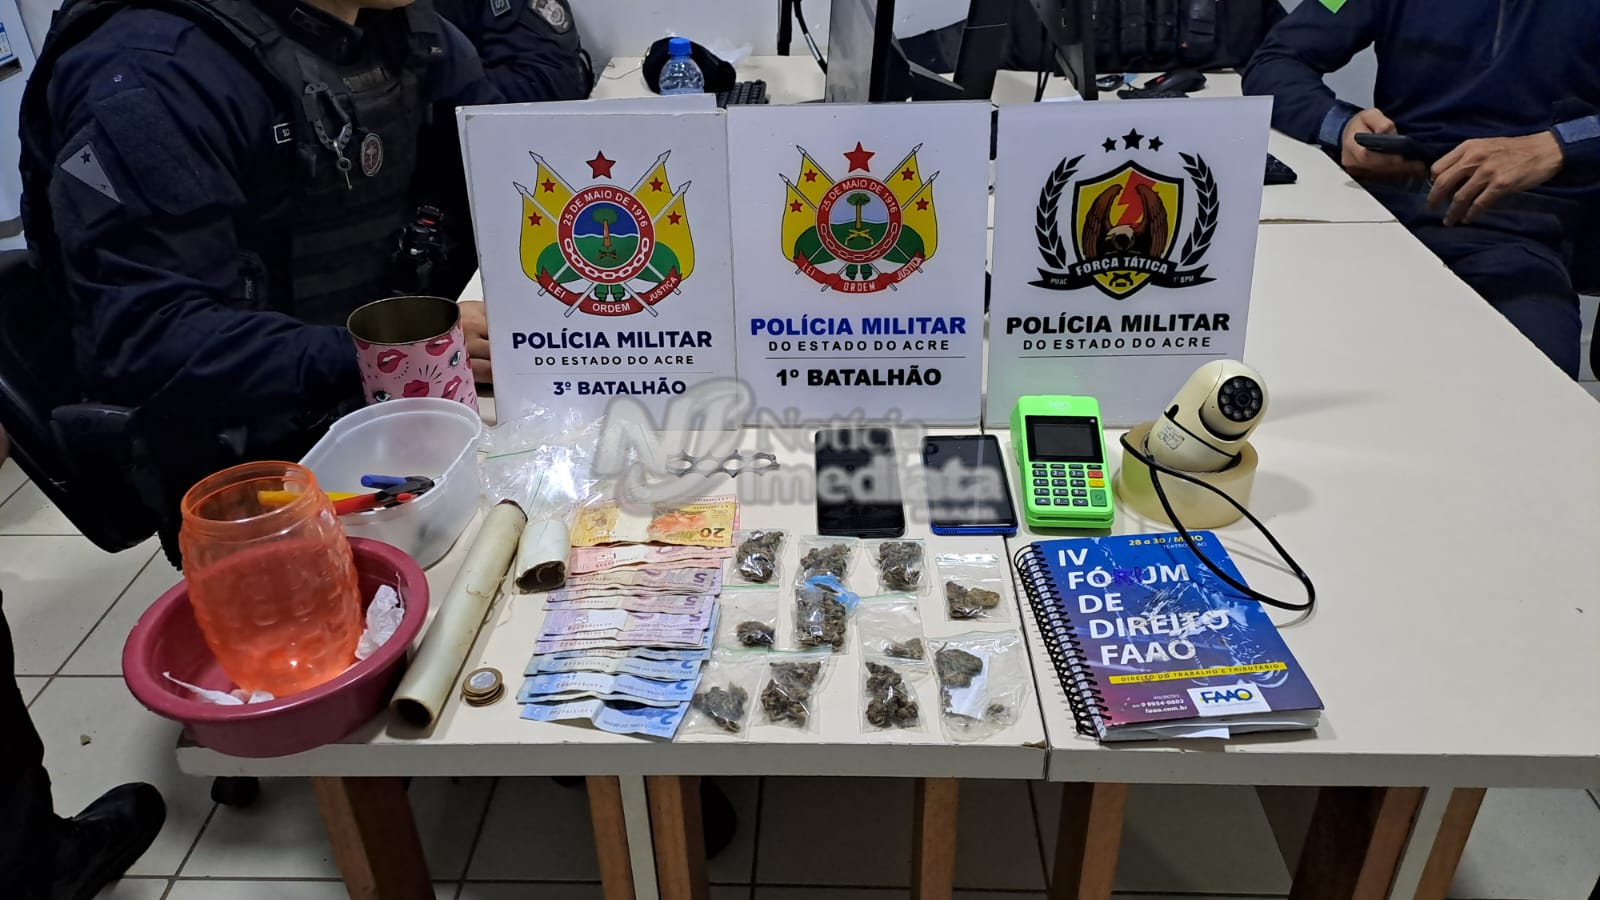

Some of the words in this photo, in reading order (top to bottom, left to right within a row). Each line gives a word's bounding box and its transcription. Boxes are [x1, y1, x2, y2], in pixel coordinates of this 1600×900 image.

[842, 180, 867, 190] MAIO
[869, 182, 884, 195] DE
[883, 192, 898, 213] 1916
[563, 212, 574, 226] 25
[569, 198, 584, 213] DE
[584, 190, 612, 202] MAIO
[615, 192, 630, 206] DE
[631, 204, 648, 227] 1916
[802, 262, 816, 277] LEI
[1075, 256, 1119, 276] FORÇA
[1123, 256, 1168, 274] TÁTICA
[548, 282, 566, 299] LEI
[648, 276, 678, 302] JUSTIÇA
[843, 282, 876, 292] ORDEM
[592, 302, 631, 313] ORDEM
[751, 314, 853, 336] POLÍCIA
[862, 316, 967, 335] MILITAR
[1006, 312, 1112, 335] POLÍCIA
[1121, 313, 1230, 332] MILITAR
[512, 328, 610, 349] POLÍCIA
[617, 331, 712, 348] MILITAR
[769, 341, 791, 351] DO
[798, 341, 867, 351] ESTADO
[874, 340, 896, 350] DO
[903, 340, 949, 350] ACRE
[1023, 340, 1046, 350] DO
[1053, 338, 1125, 350] ESTADO
[1132, 338, 1156, 348] DO
[1162, 336, 1211, 347] ACRE
[534, 356, 556, 366] DO
[561, 356, 622, 366] ESTADO
[627, 356, 648, 365] DO
[654, 355, 694, 365] ACRE
[807, 365, 941, 387] BATALHÃO
[577, 377, 686, 396] BATALHÃO
[1153, 537, 1166, 545] 30
[1058, 549, 1088, 567] IV
[1078, 593, 1124, 614] DE
[1089, 609, 1230, 639] DIREITO
[1100, 639, 1197, 666] FAAO
[1120, 674, 1155, 683] DIREITO
[1158, 672, 1170, 680] DO
[1173, 669, 1218, 678] TRABALHO
[1228, 663, 1280, 674] TRIBUTÁRIO
[1200, 688, 1253, 704] FAAO
